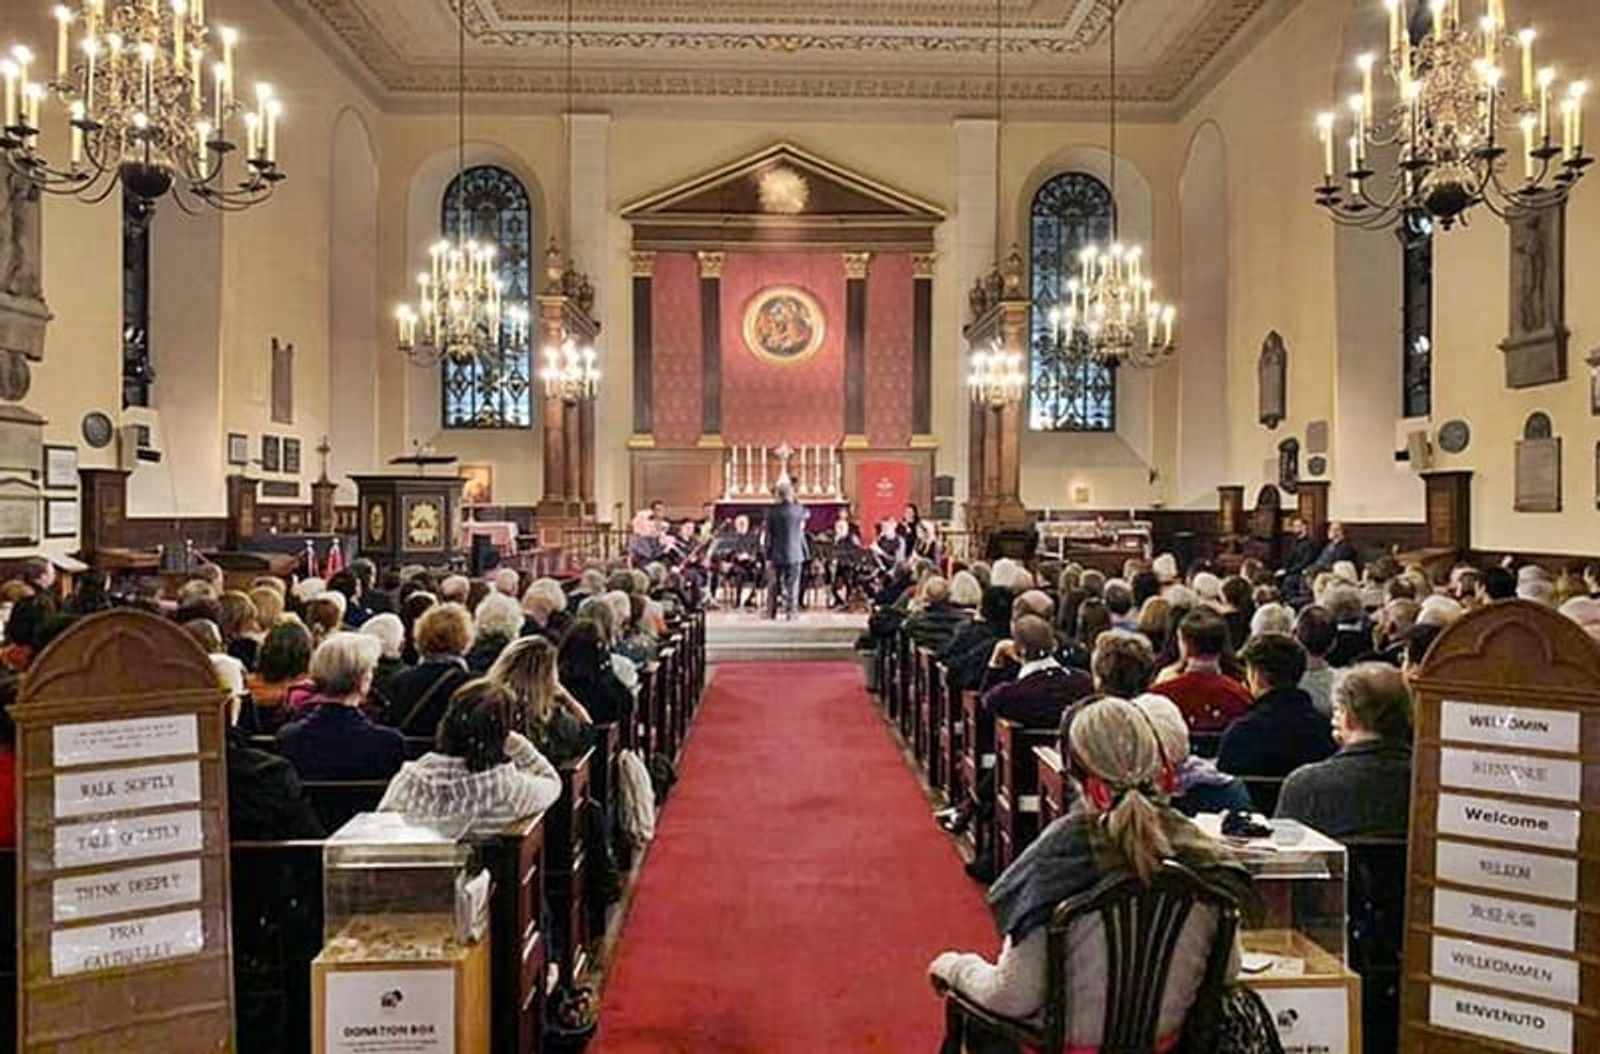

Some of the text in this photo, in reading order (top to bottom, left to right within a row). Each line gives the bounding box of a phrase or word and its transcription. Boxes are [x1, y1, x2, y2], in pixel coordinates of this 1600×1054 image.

[80, 775, 175, 798] WALK SOFTLY
[1465, 806, 1549, 831] Welcome
[75, 874, 180, 901] THINK DEEPLY
[110, 924, 144, 940] PRAY
[1451, 951, 1552, 982] WILLKOMMEN
[1456, 1001, 1545, 1030] BENVENUTO
[343, 1024, 435, 1038] DONATION BOX
